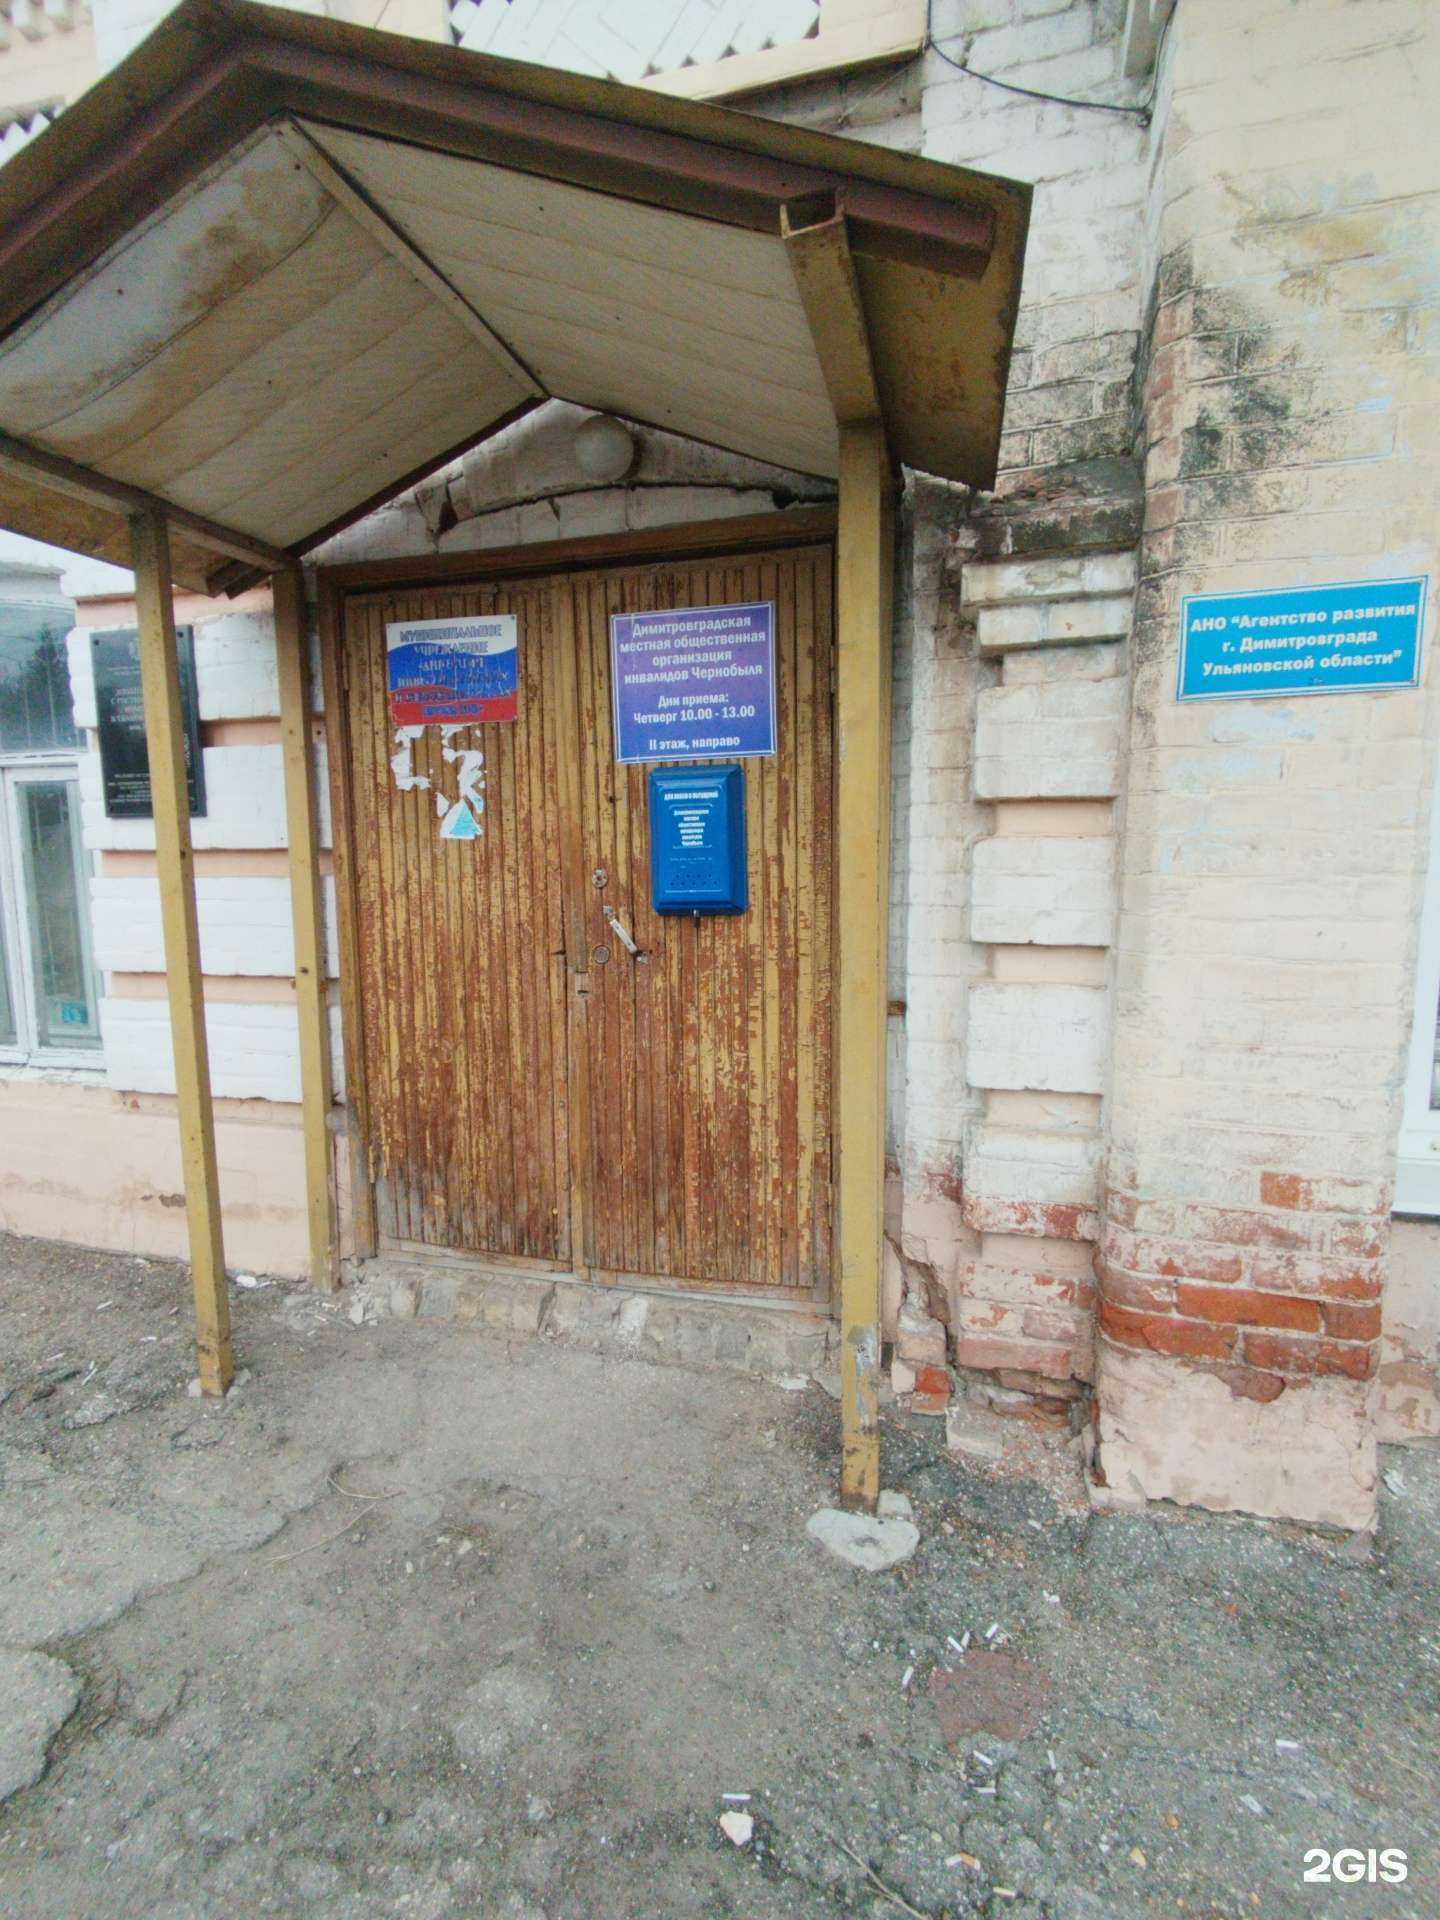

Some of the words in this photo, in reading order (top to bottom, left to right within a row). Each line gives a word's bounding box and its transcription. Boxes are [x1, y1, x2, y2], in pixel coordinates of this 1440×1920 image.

[632, 616, 751, 638] Димитровградская
[1190, 616, 1226, 632] АНО
[1332, 603, 1416, 623] развития
[620, 639, 671, 653] местная
[674, 631, 766, 648] общественная
[1221, 640, 1235, 653] г.
[1240, 630, 1378, 653] Димитровграда
[653, 650, 732, 668] организация
[1202, 655, 1314, 676] Ульяновской
[624, 670, 689, 685] инвалидов
[692, 664, 762, 680] Чернобыля
[658, 695, 680, 709] Дни
[682, 693, 729, 707] приема:
[634, 711, 677, 725] Четверг
[680, 708, 712, 721] 10.00
[723, 705, 755, 719] 13.00
[659, 738, 689, 750] этаж,
[692, 736, 740, 750] направо
